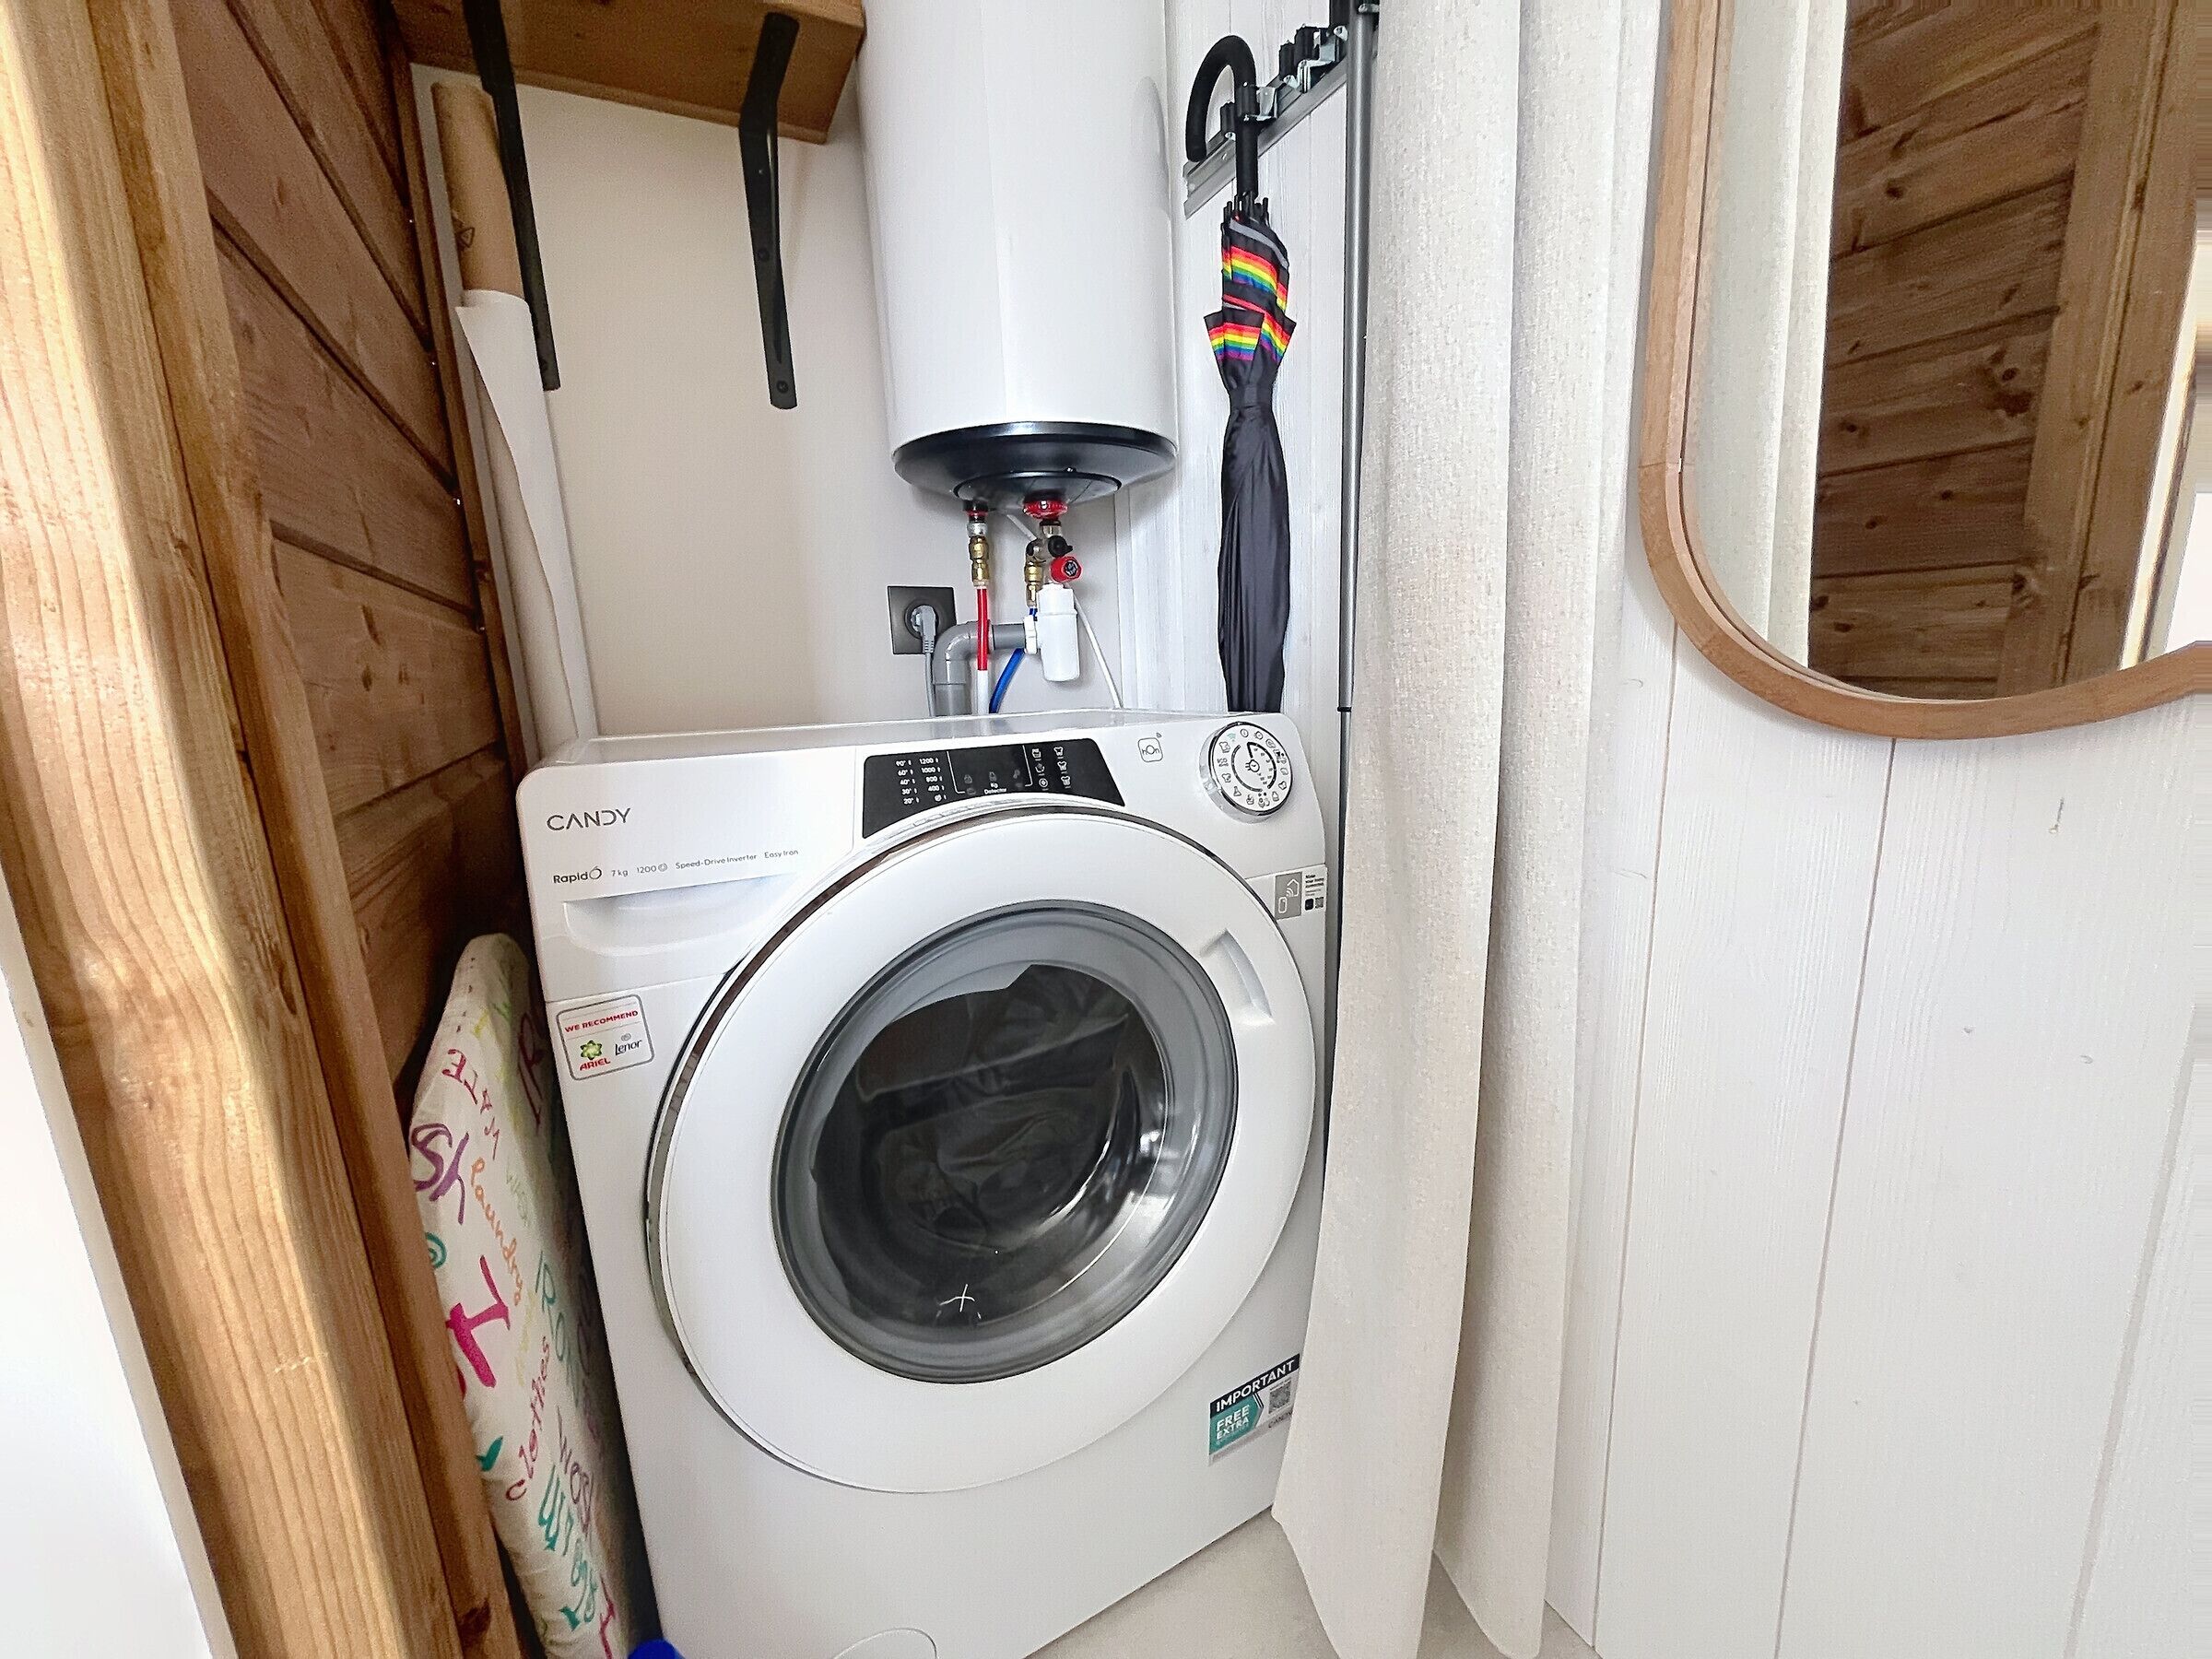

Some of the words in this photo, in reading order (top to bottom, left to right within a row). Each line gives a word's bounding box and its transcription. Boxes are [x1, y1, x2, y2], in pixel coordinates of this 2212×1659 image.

[547, 807, 630, 831] CANDY
[636, 865, 657, 874] 1200
[726, 853, 757, 863] Inverter
[764, 850, 782, 859] Easy
[782, 848, 799, 857] Iron
[564, 1024, 581, 1033] WE
[582, 1010, 639, 1029] RECOMMEND
[615, 1040, 642, 1056] Lenor
[579, 1057, 611, 1071] ARIEL
[1216, 1359, 1295, 1412] IMPORTANT
[1216, 1416, 1250, 1441] EXTRA
[1217, 1404, 1251, 1432] FREE
